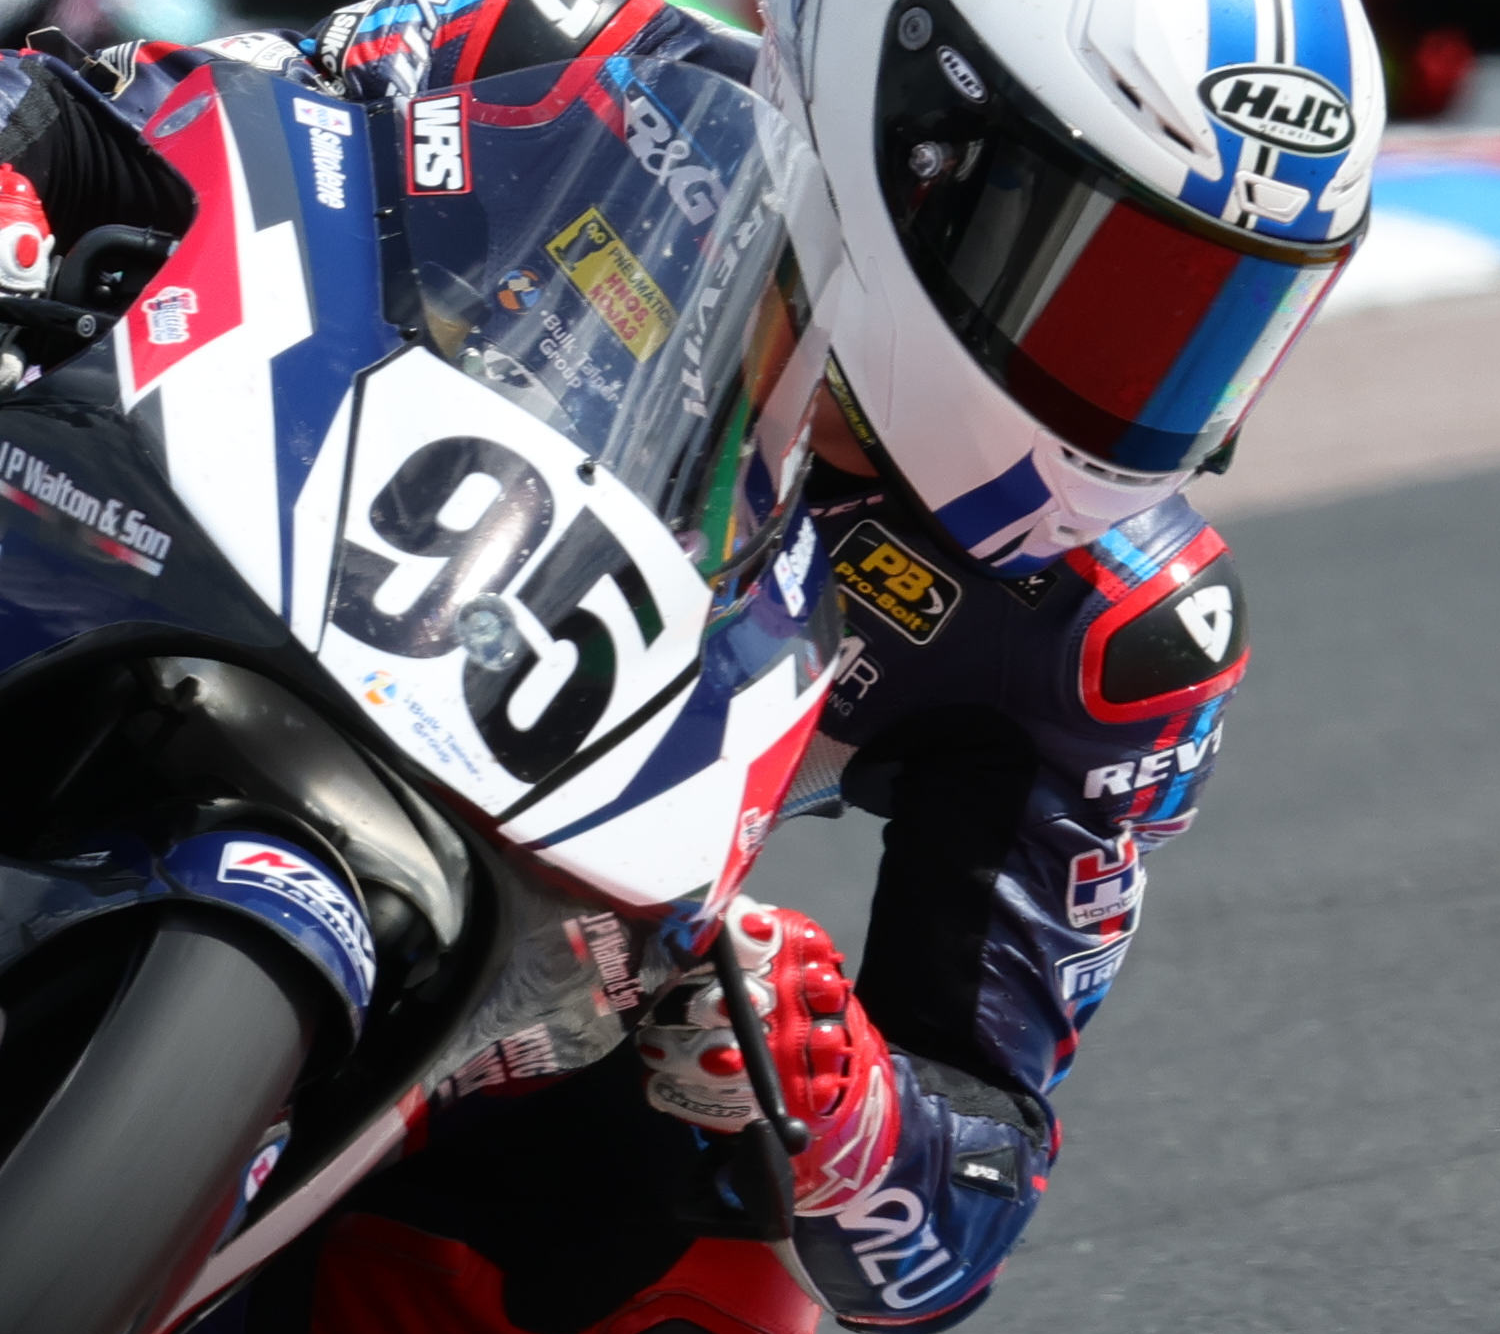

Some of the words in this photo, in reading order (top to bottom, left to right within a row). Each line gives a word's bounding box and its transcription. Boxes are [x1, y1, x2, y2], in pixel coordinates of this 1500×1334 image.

[414, 96, 464, 190] WRS
[1222, 79, 1344, 138] HJC
[624, 95, 727, 226] R&G
[540, 338, 582, 388] Group
[22, 455, 101, 526] Walton
[97, 499, 123, 537] &
[118, 509, 172, 560] Son
[329, 435, 667, 785] 95
[859, 543, 935, 602] PB
